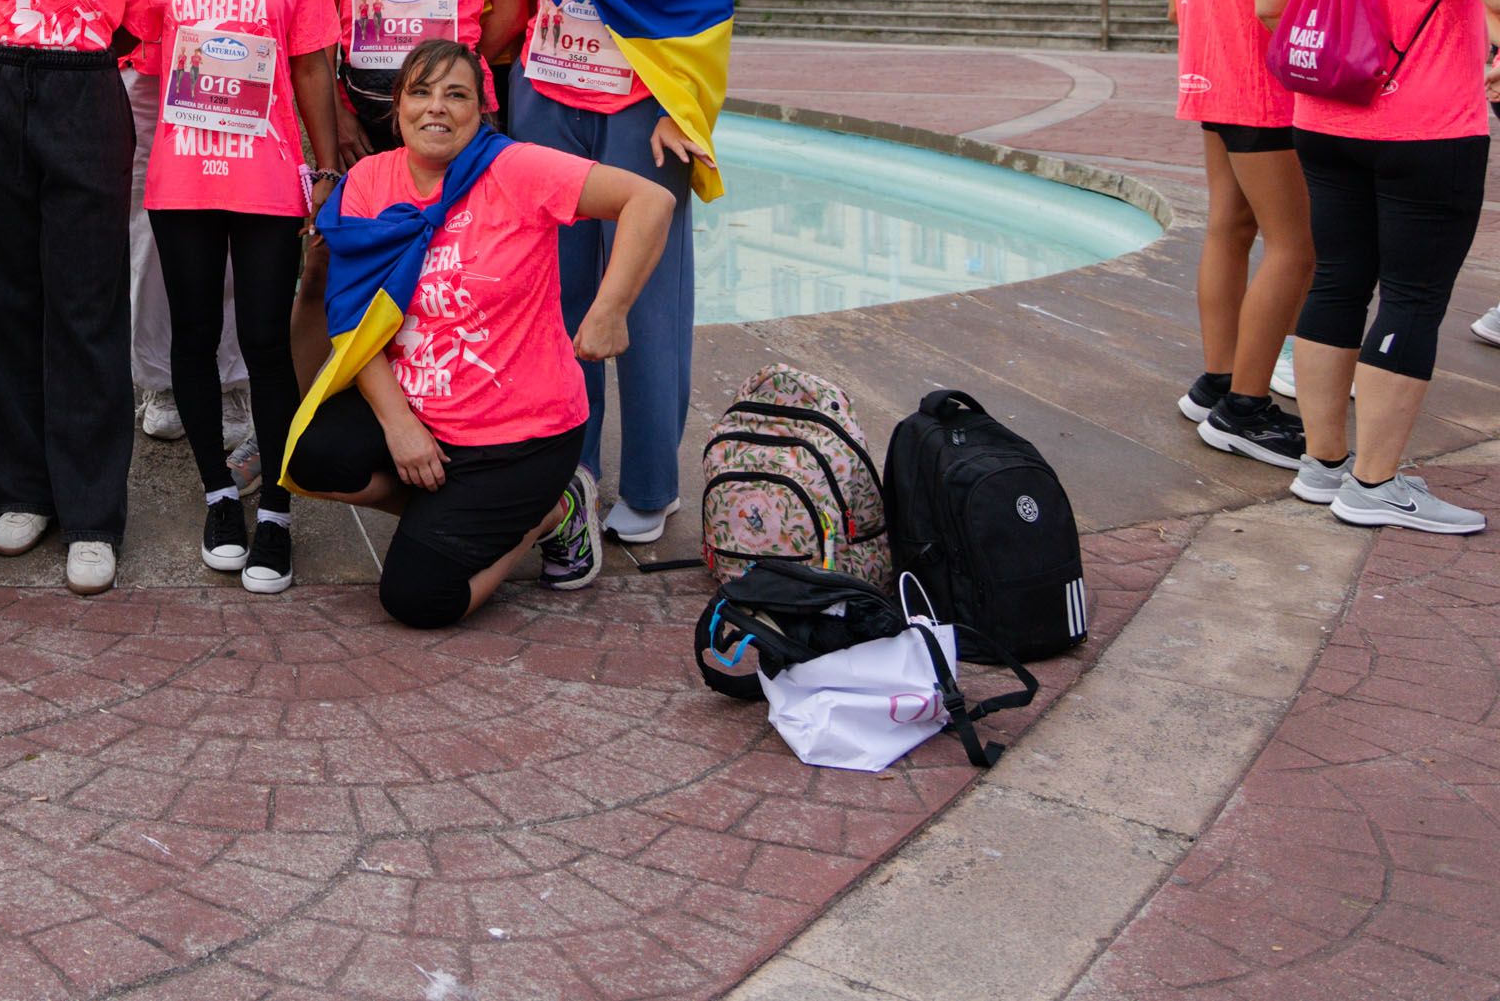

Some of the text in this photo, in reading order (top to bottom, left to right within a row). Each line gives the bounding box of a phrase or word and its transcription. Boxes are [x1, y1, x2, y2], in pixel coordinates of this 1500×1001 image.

[1306, 9, 1318, 27] A
[40, 17, 64, 45] LA
[384, 18, 423, 34] 016
[205, 43, 245, 57] ASTURIANA
[562, 34, 600, 53] 016
[361, 56, 394, 64] OYSHO
[537, 56, 558, 65] CARRERA
[572, 62, 590, 71] MUJER
[568, 54, 588, 63] 3549
[537, 67, 567, 79] OYSHO
[200, 75, 241, 95] 016
[586, 78, 618, 88] Santander
[174, 99, 196, 107] CARRERA
[212, 105, 231, 113] MUJER
[175, 111, 206, 123] OYSHO
[227, 120, 257, 130] Santander
[174, 126, 254, 158] MUJER
[202, 160, 229, 176] 2026
[421, 283, 456, 318] DE
